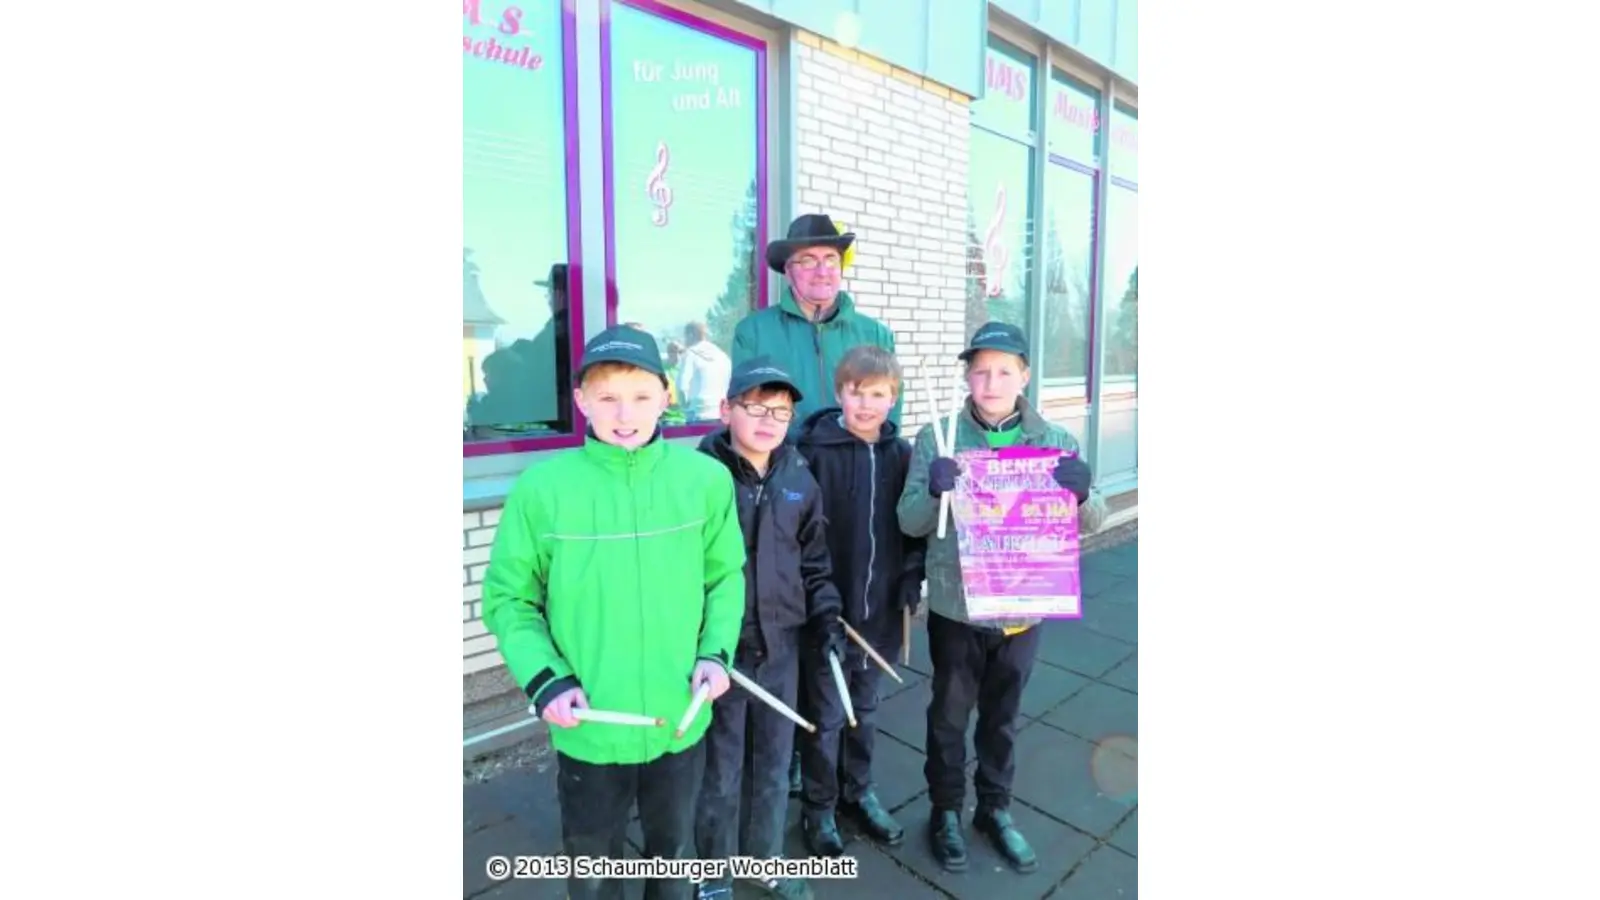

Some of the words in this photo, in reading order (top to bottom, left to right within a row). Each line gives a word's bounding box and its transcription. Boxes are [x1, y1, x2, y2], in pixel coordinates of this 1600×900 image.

[669, 58, 720, 86] Jung
[671, 87, 711, 112] und
[987, 458, 1058, 475] BENEF
